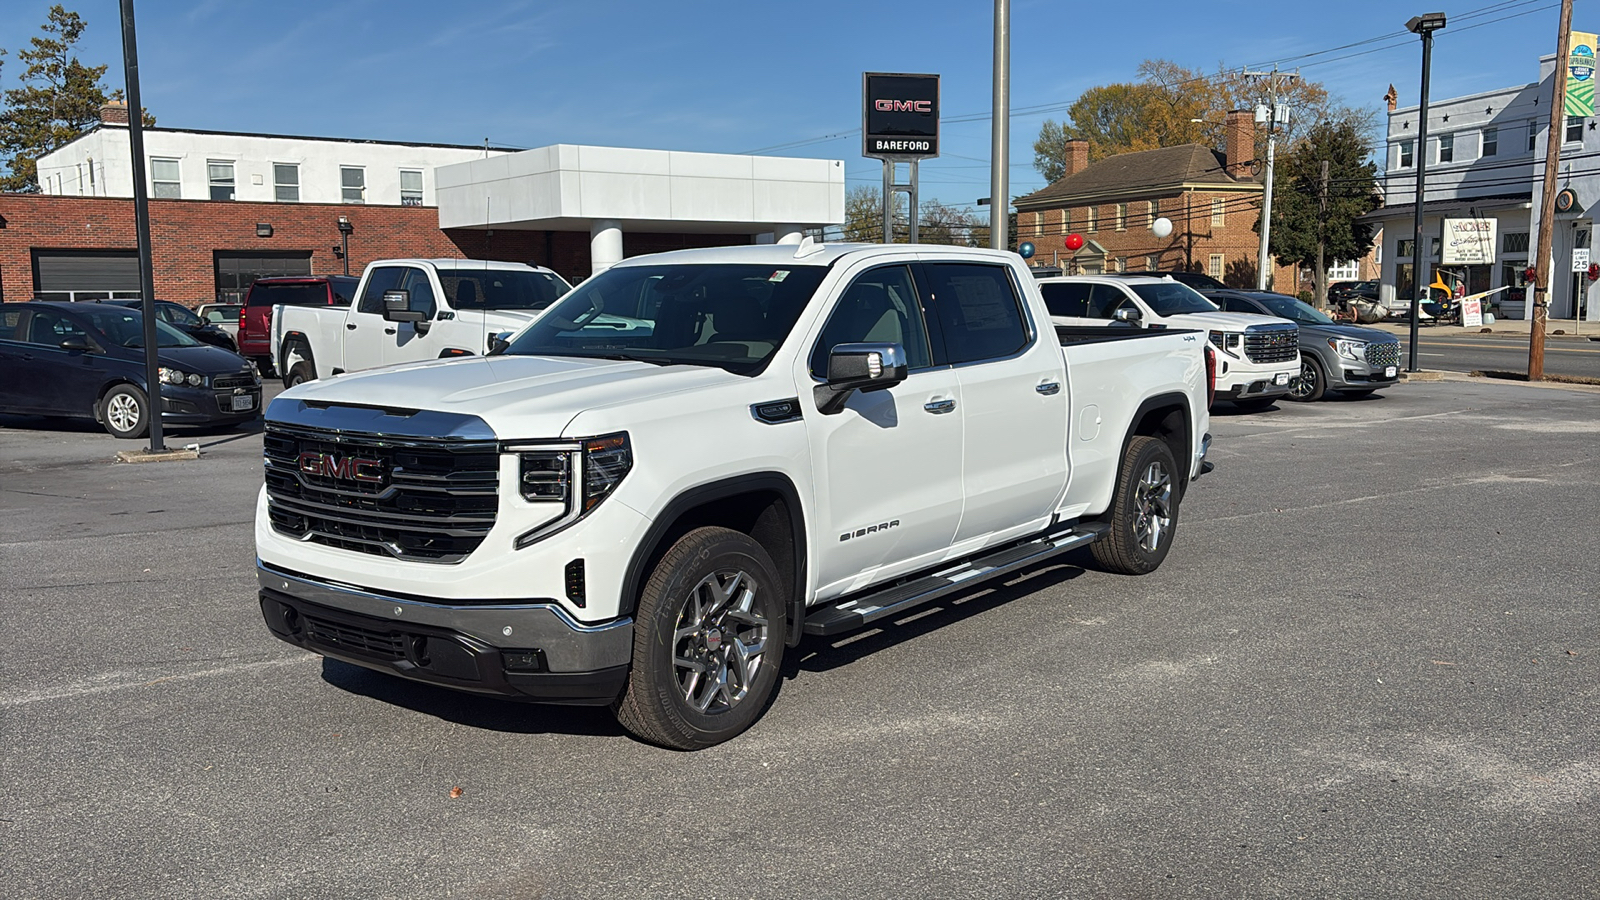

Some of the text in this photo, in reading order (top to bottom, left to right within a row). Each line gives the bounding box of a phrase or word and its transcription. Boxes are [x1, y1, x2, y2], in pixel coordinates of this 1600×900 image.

[875, 99, 931, 112] GMC
[876, 140, 929, 151] BAREFORD
[1574, 261, 1588, 269] 25
[299, 451, 384, 484] GMC
[839, 519, 900, 542] SIERRA
